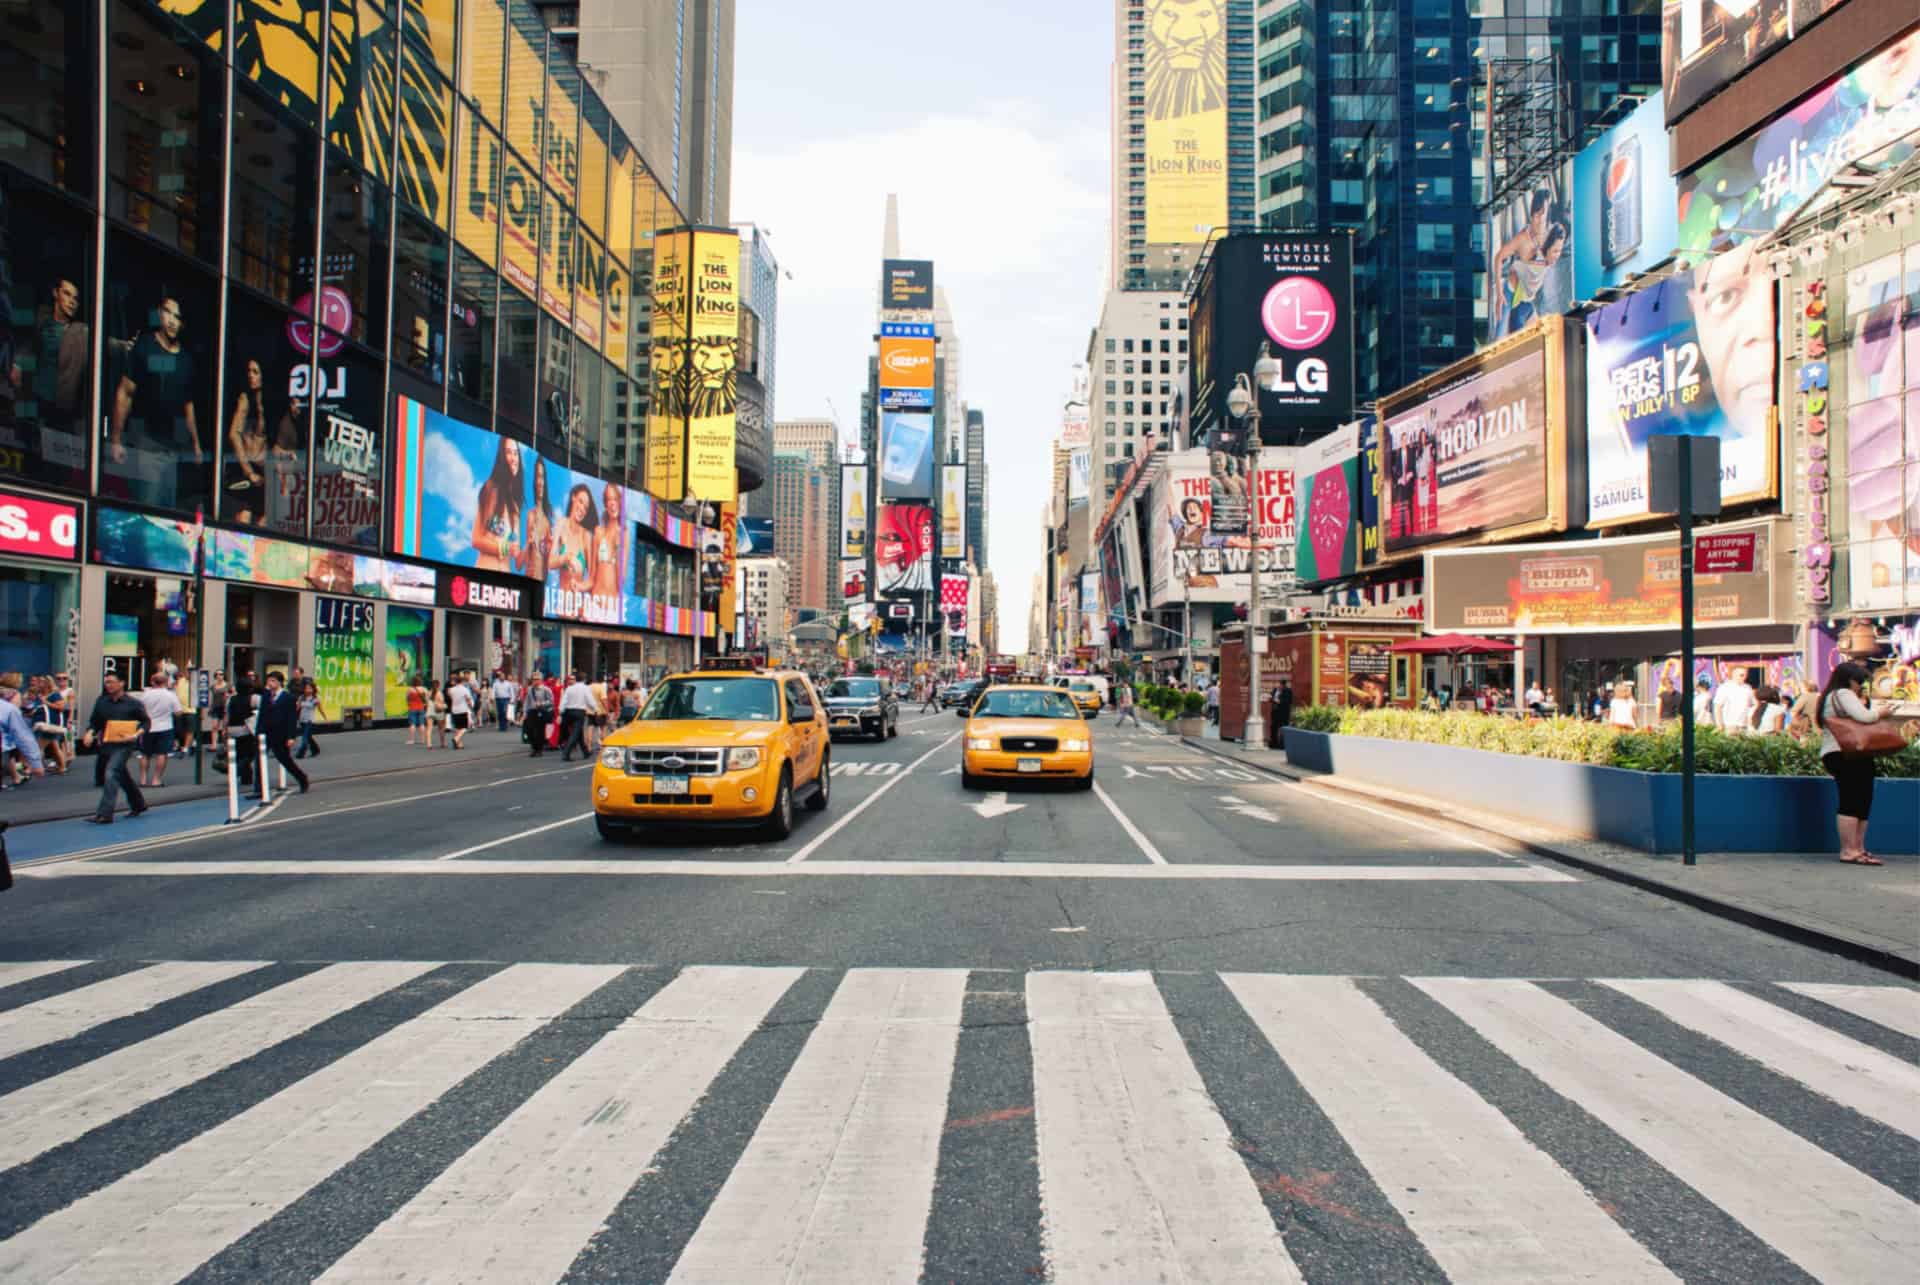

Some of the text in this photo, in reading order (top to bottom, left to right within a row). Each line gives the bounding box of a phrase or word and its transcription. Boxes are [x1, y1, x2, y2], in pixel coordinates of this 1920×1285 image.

[1174, 140, 1200, 151] THE
[1150, 155, 1222, 174] LION KING
[1263, 243, 1330, 253] BARNEYS
[703, 263, 728, 274] THE
[699, 276, 732, 293] LION
[696, 295, 735, 314] KING
[1270, 357, 1328, 392] LG
[1663, 342, 1700, 392] 12
[1633, 395, 1664, 419] JULY
[327, 415, 375, 453] TEEN
[1440, 399, 1527, 459] HORIZON
[1593, 487, 1644, 508] SAMUEL
[1699, 537, 1750, 548] NO STOPPING
[1707, 549, 1740, 558] ANYTIME
[1531, 567, 1589, 580] BUBBA
[469, 582, 520, 611] ELEMENT
[317, 599, 373, 632] LIFE'S
[316, 633, 356, 651] BETTER
[315, 656, 373, 681] BOARD
